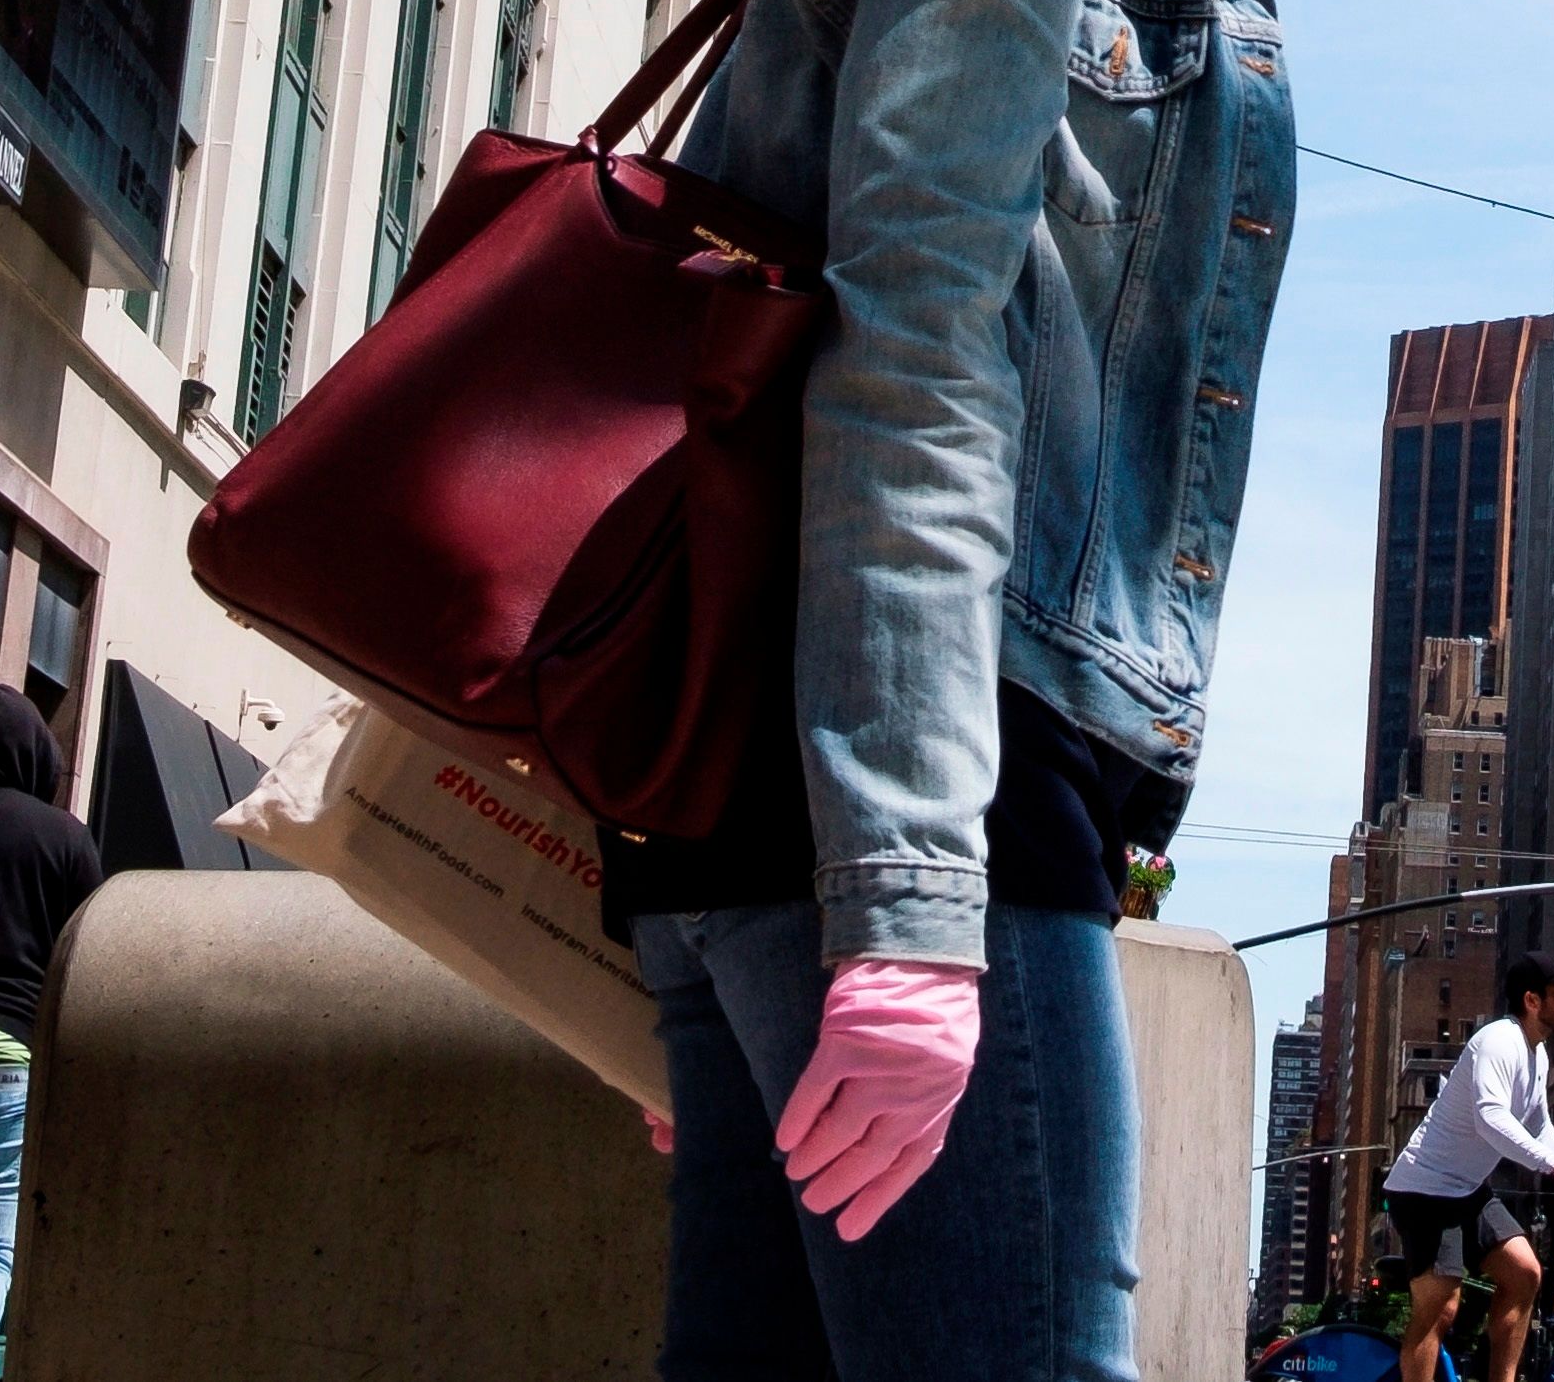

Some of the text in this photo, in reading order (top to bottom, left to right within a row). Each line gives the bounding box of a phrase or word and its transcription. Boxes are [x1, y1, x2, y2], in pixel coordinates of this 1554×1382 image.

[346, 786, 504, 898] AmritaHealthFoods.com
[1283, 1355, 1338, 1372] citi bike
